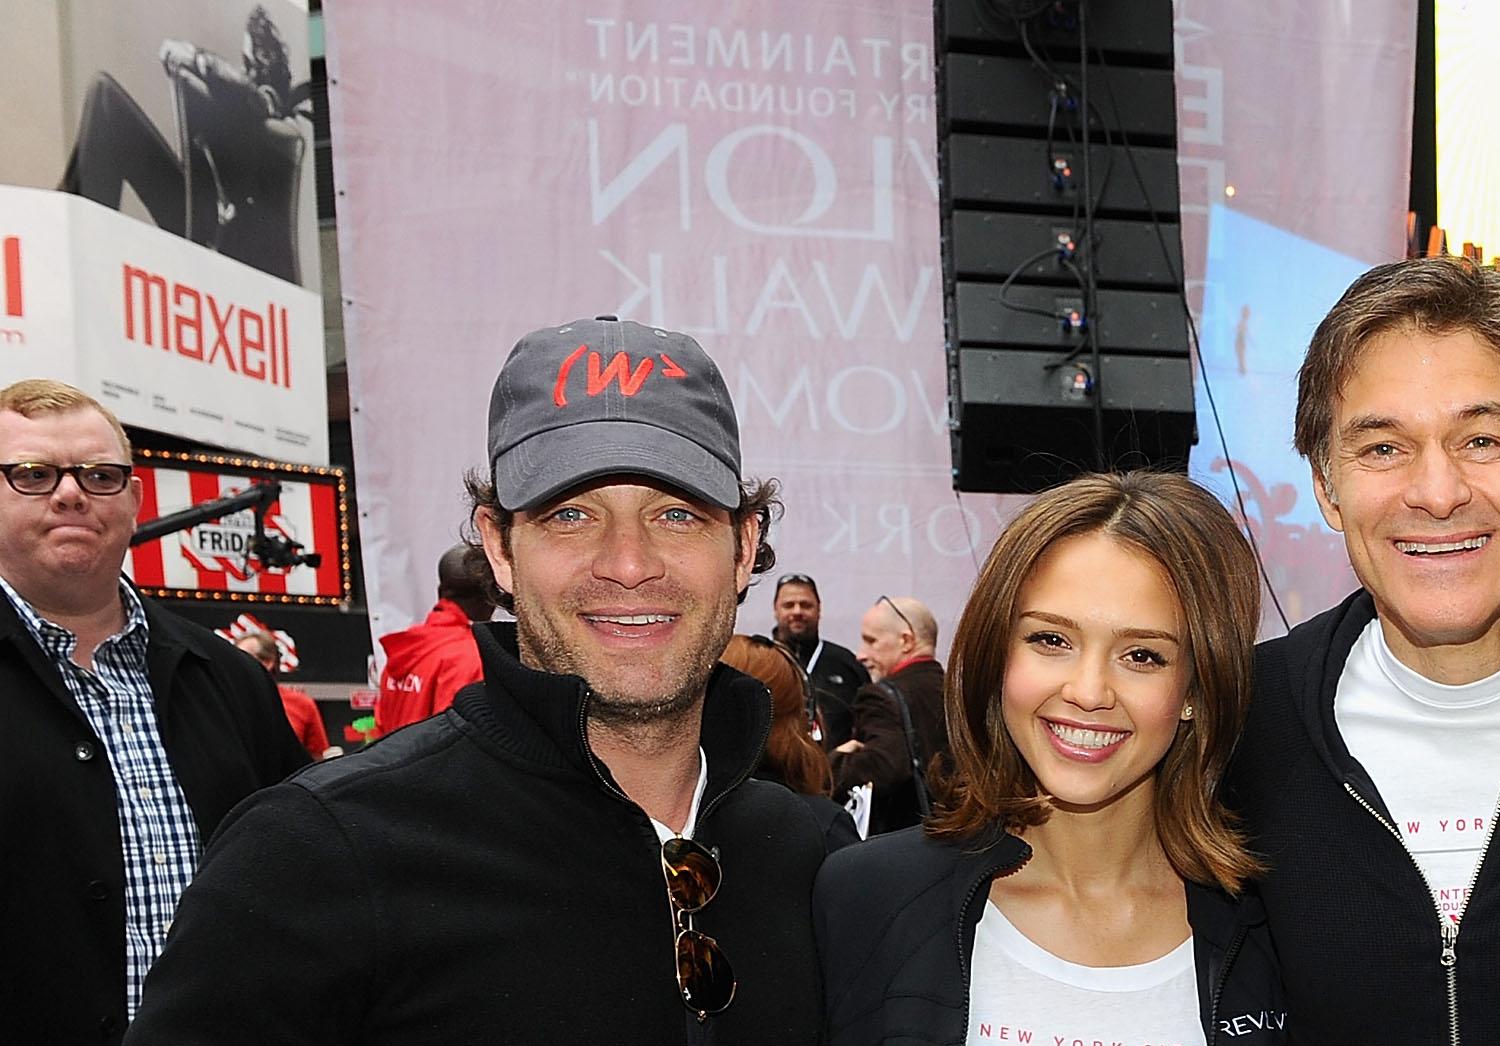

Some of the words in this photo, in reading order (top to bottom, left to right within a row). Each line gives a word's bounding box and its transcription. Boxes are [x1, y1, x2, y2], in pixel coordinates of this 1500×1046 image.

[122, 262, 291, 390] maxell
[1439, 818, 1484, 832] YOR
[979, 1023, 1034, 1044] NEW
